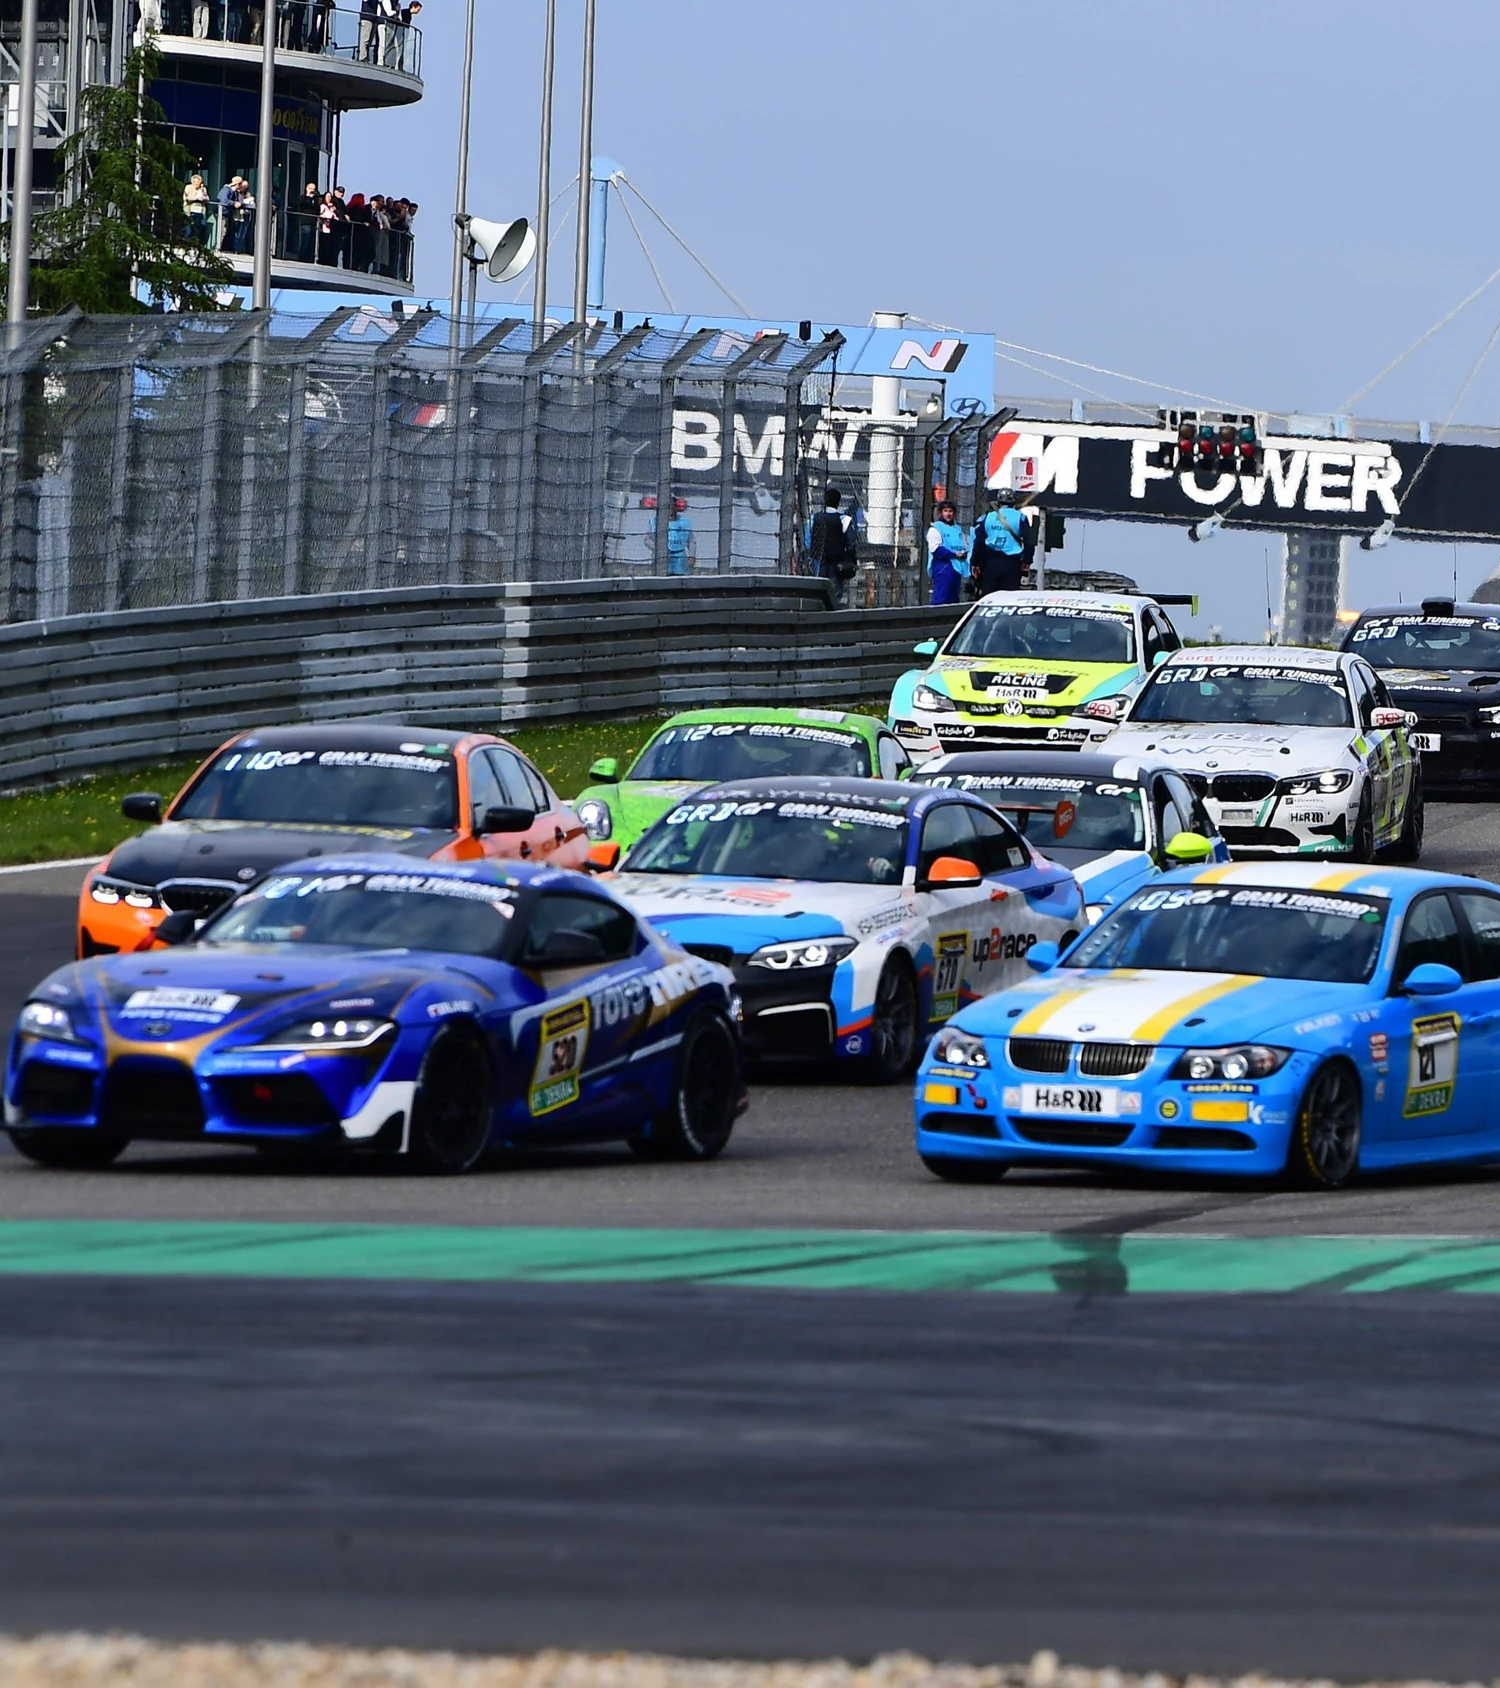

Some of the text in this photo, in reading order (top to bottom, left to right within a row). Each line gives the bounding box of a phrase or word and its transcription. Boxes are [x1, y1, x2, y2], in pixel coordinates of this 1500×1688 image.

[890, 338, 968, 373] N
[670, 409, 861, 476] BMW
[1130, 440, 1402, 515] POWER
[979, 606, 1017, 618] 124
[1045, 608, 1129, 622] GRAN TURISMO
[1392, 616, 1475, 626] GRAN TURISMO
[1352, 625, 1399, 642] GRD
[1176, 654, 1214, 663] sorg
[991, 675, 1048, 687] RACING
[1155, 667, 1208, 684] GRD
[1243, 667, 1339, 683] GRAN TURISMO
[664, 724, 712, 744] 112
[748, 724, 857, 744] GRAN TURISMO
[224, 751, 280, 770] 110
[319, 751, 443, 773] GRAN TURISMO
[971, 776, 1087, 789] GRAN TURISMO
[778, 803, 907, 825] GRAN TURISMO
[1290, 811, 1311, 823] H&R
[1231, 890, 1371, 916] GRAN TURISMO
[973, 927, 1038, 971] up2race
[936, 957, 959, 992] 670
[1035, 1088, 1075, 1109] H&R
[1419, 1088, 1447, 1111] DEKRA
